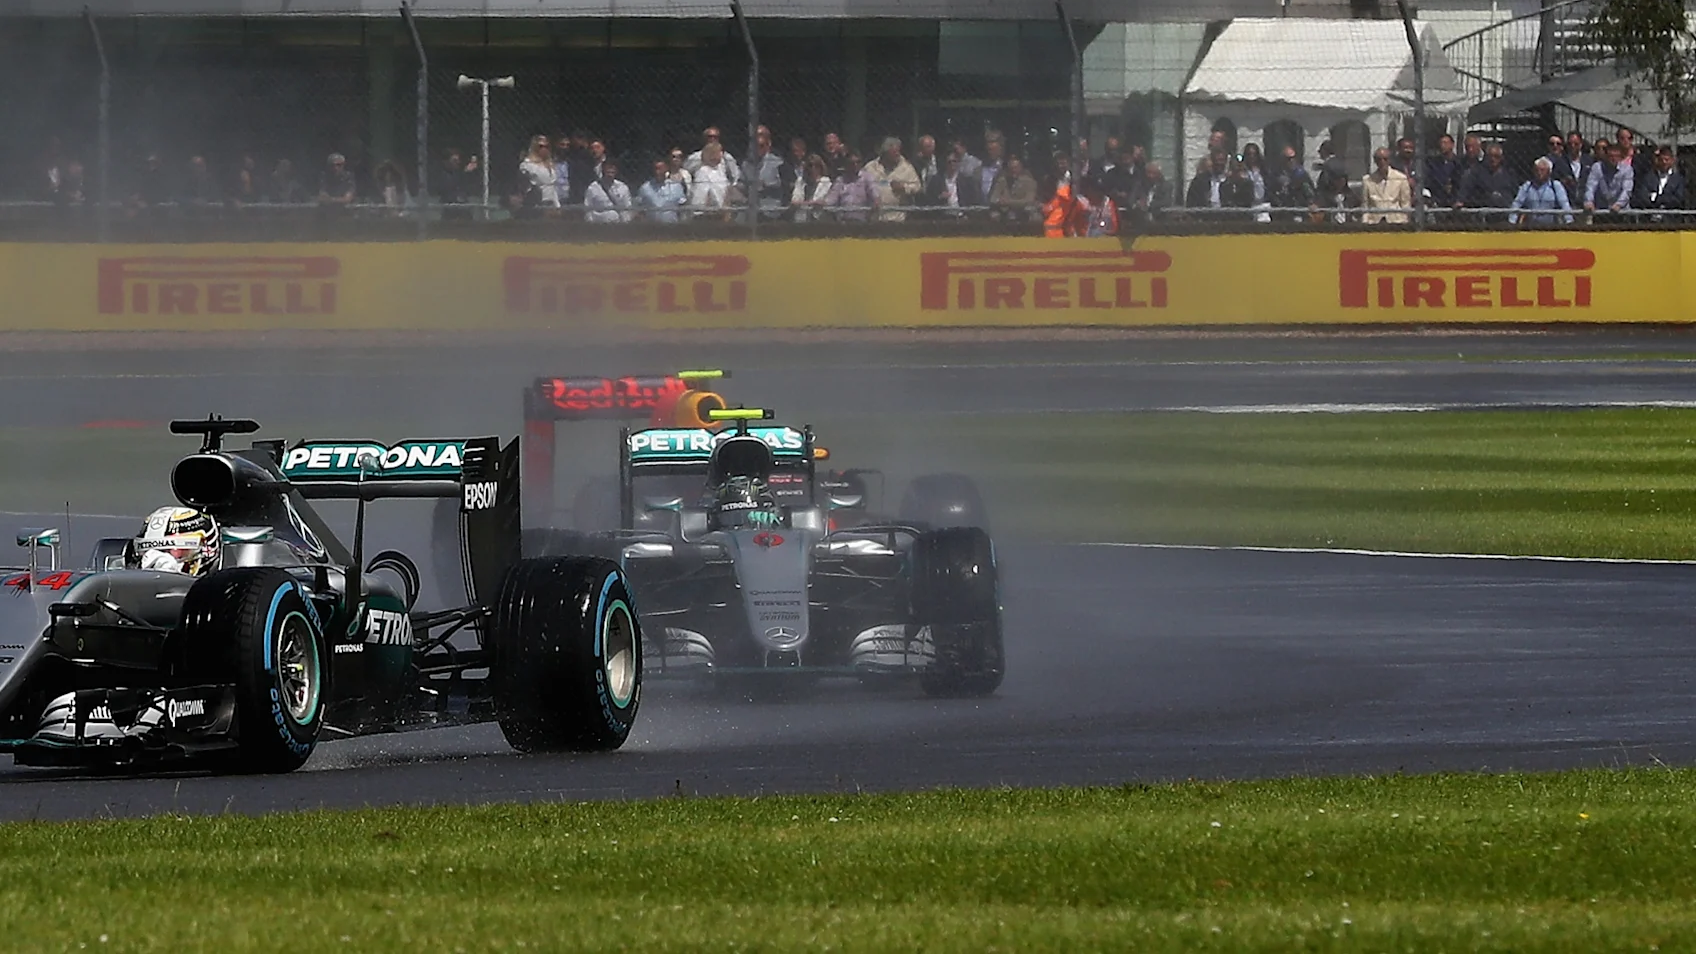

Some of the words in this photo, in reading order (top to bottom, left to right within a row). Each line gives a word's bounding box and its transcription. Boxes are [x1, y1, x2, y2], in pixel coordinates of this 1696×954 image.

[97, 255, 340, 315] PIRELLI
[503, 254, 750, 314] PIRELLI
[920, 250, 1172, 310] PIRELLI
[1339, 248, 1596, 309] PIRELLI
[285, 445, 464, 471] PETRONA
[630, 431, 803, 452] PETRAS
[464, 481, 498, 510] EPSON
[334, 642, 364, 654] PETRONAS
